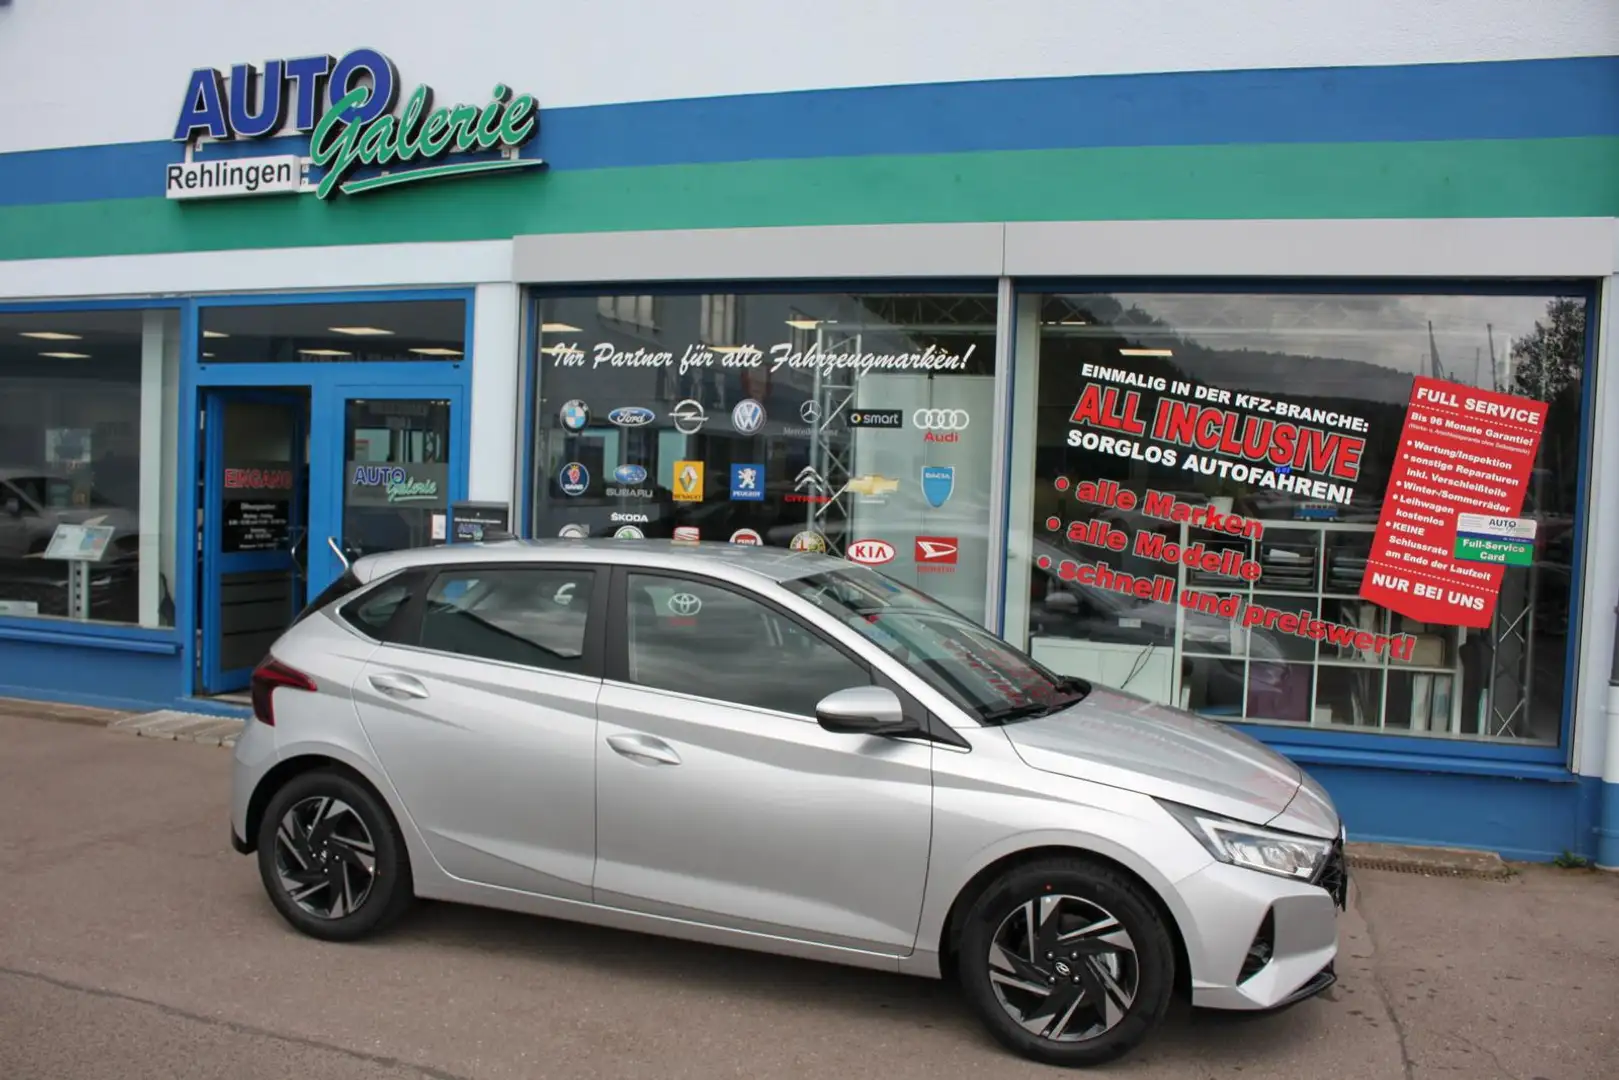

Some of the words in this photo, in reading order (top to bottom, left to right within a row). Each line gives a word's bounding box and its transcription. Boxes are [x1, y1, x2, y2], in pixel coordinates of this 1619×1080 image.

[172, 46, 393, 142] AUTO
[310, 83, 534, 199] Galerie
[167, 163, 291, 190] Rehlingen
[551, 342, 585, 367] Ihr
[592, 342, 674, 369] Partner
[679, 344, 714, 375] für
[770, 342, 976, 376] Fahrzeugmarken!
[1081, 363, 1167, 391] EINMALIG
[1171, 381, 1191, 396] IN
[1195, 385, 1232, 405] DER
[1235, 393, 1369, 432] KFZ-BRANCHE:
[1417, 387, 1459, 408] FULL
[1464, 398, 1541, 425] SERVICE
[617, 410, 646, 423] Ford
[863, 413, 899, 424] smart
[1411, 412, 1427, 423] Bis
[1445, 418, 1482, 435] Monate
[1485, 429, 1534, 446] Garantie!
[924, 432, 959, 442] Audi
[1069, 382, 1147, 437] ALL
[1150, 397, 1366, 482] INCLUSIVE
[1067, 429, 1178, 466] SORGLOS
[1182, 454, 1354, 505] AUTOFAHREN!
[1414, 440, 1512, 470] Wartung/Inspektion
[353, 466, 406, 485] AUTO
[1407, 468, 1428, 480] inkl.
[1431, 473, 1507, 498] Verschleißteile
[1410, 455, 1453, 471] sonstige
[1455, 464, 1519, 486] Reparaturen
[606, 488, 654, 498] SUBARU
[1400, 495, 1454, 515] Leihwagen
[611, 512, 648, 523] ŠKODA
[1076, 478, 1137, 511] alle
[1142, 489, 1264, 540] Marken
[1396, 508, 1445, 527] kostenlos
[1489, 519, 1517, 528] AUTO
[1392, 522, 1425, 536] KEINE
[855, 546, 887, 558] KIA
[1067, 519, 1128, 551] alle
[1133, 530, 1262, 581] Modelle
[1389, 535, 1448, 556] Schlussrate
[1462, 538, 1525, 553] Full-Service
[1480, 551, 1506, 561] Card
[1385, 550, 1401, 560] am
[1403, 552, 1428, 565] Ende
[1430, 559, 1448, 571] der
[1450, 563, 1492, 581] Laufzeit
[1372, 572, 1410, 592] NUR
[1413, 582, 1443, 600] BEI
[1447, 591, 1485, 610] UNS
[1058, 560, 1175, 604] schnell
[1180, 589, 1242, 620] und
[1242, 602, 1417, 661] preiswert!
